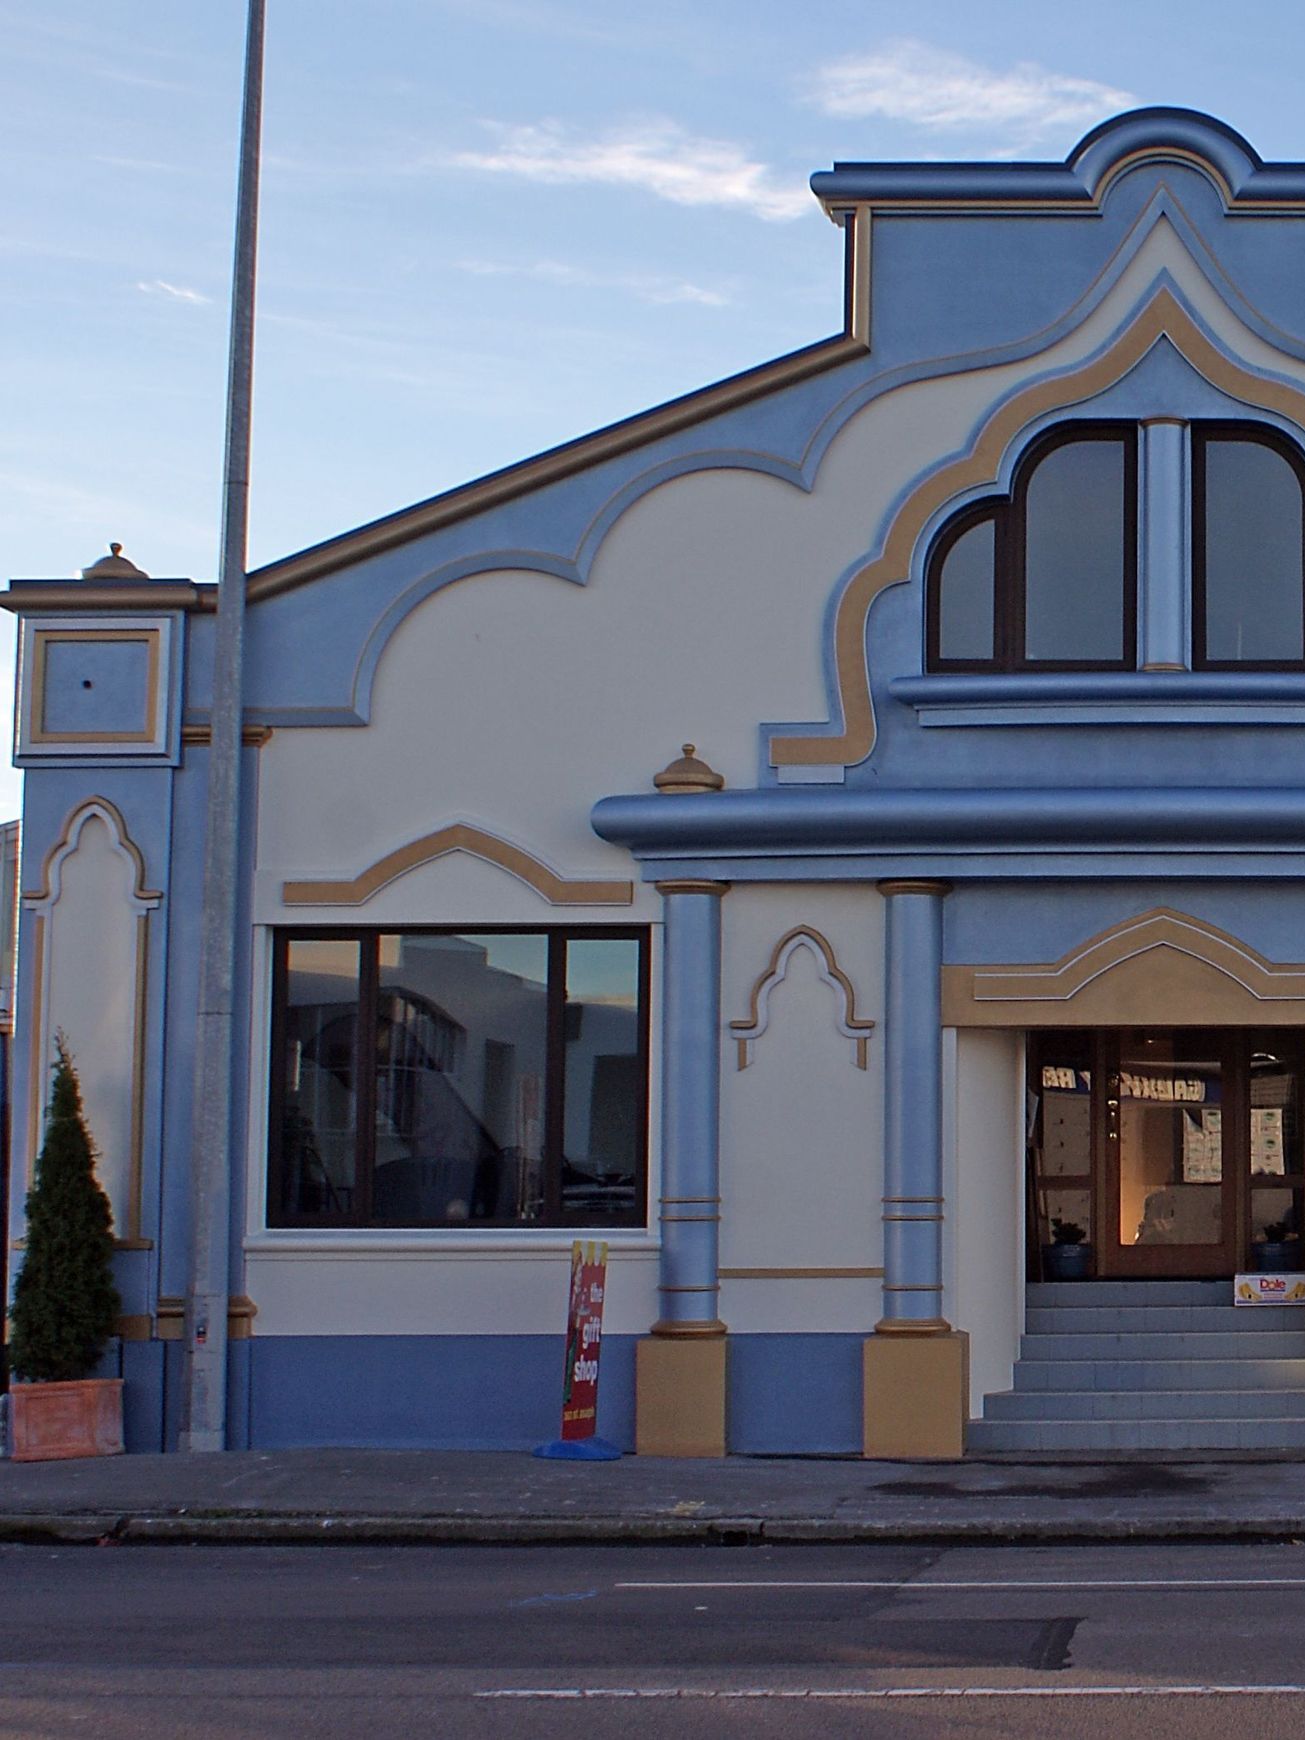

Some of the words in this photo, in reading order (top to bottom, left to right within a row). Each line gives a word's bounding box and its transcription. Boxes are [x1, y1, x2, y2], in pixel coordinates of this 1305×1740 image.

[590, 1282, 603, 1303] the
[1260, 1279, 1286, 1289] Dole
[583, 1316, 601, 1349] gift
[574, 1354, 597, 1386] shop
